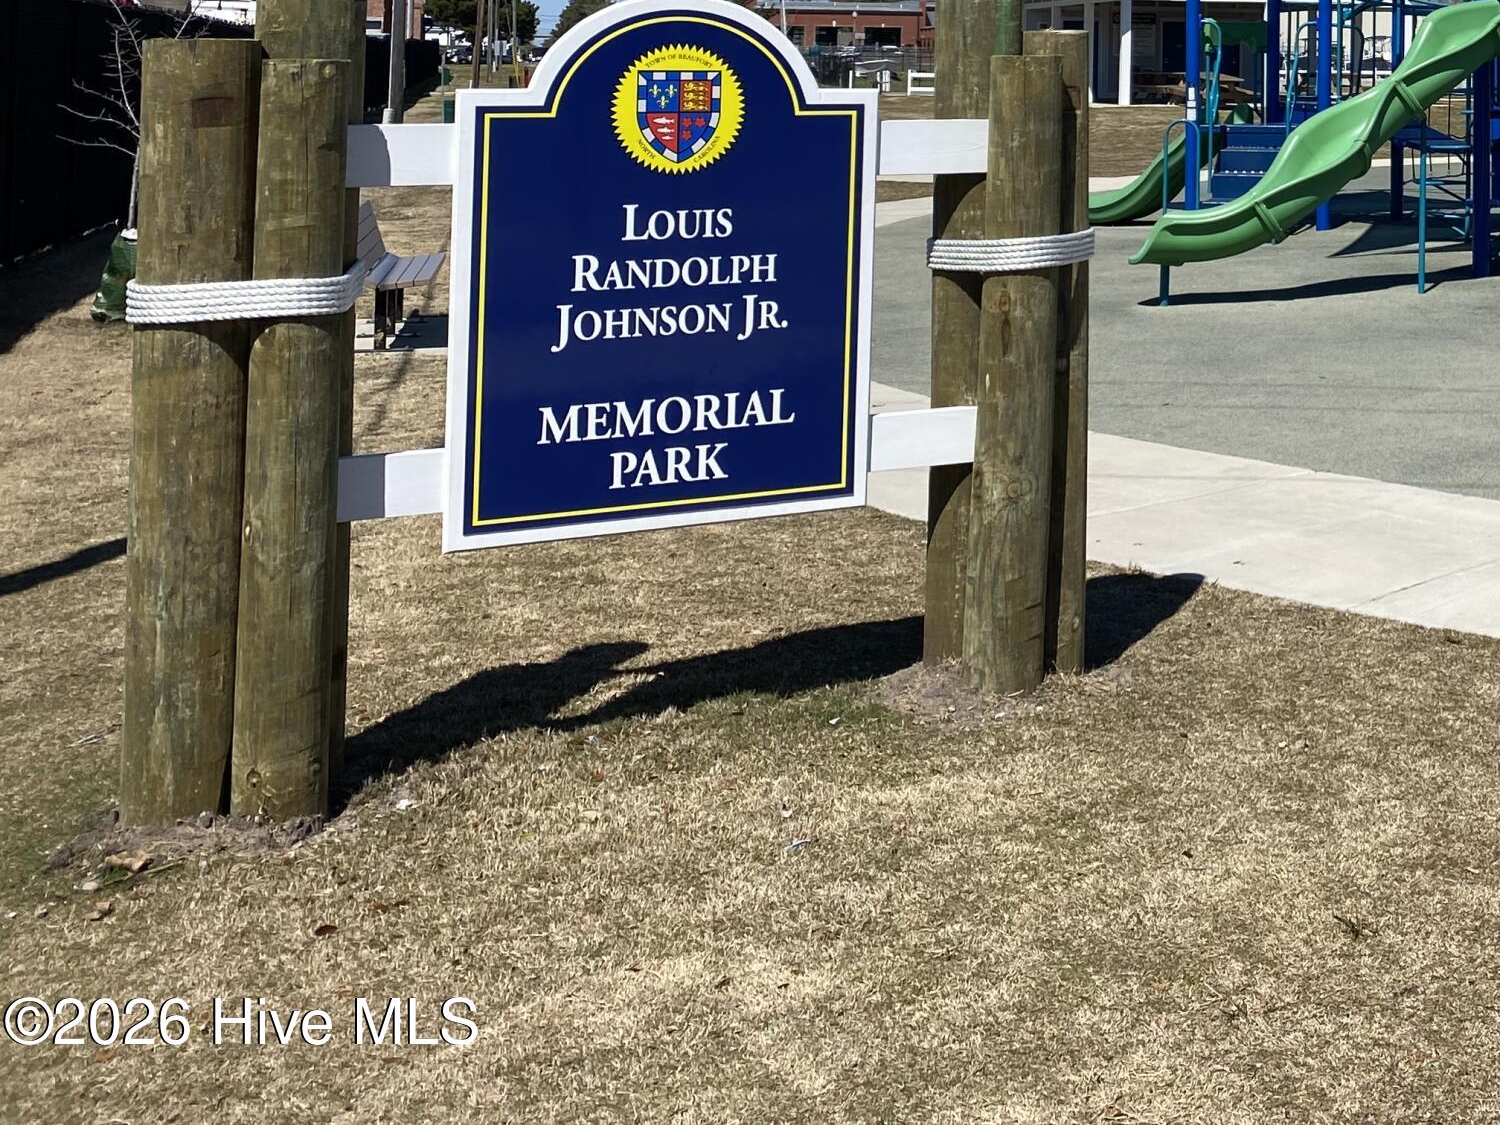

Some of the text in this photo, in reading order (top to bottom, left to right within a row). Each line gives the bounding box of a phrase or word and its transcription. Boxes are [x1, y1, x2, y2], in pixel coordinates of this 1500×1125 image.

[645, 56, 666, 68] TOWN
[637, 138, 656, 160] NORTH
[693, 135, 721, 163] CAROLINA
[621, 204, 733, 241] LOUIS
[570, 253, 778, 292] RANDOLPH
[550, 294, 789, 353] JOHNSON JR.
[536, 388, 796, 446] MEMORIAL
[608, 443, 729, 491] PARK
